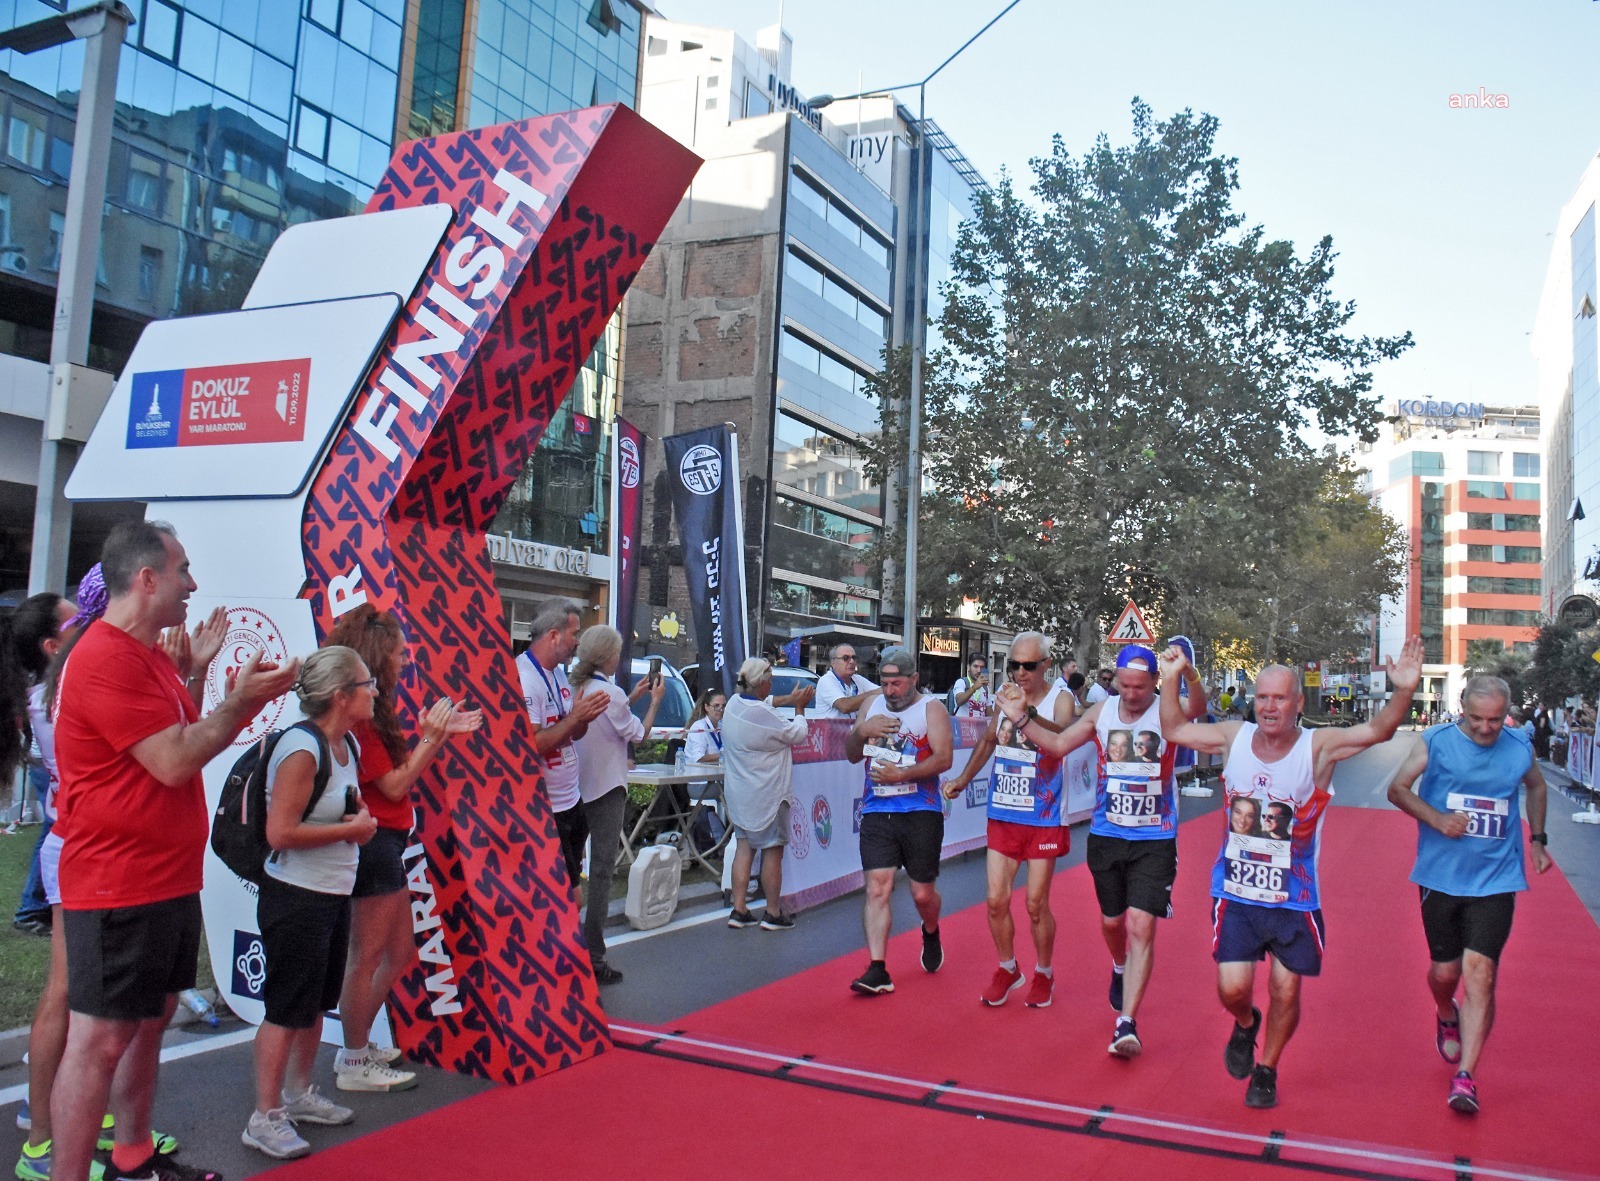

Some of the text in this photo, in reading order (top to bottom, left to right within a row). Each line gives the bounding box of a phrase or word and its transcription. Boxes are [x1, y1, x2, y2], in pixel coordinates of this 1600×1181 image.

[850, 135, 889, 163] my
[353, 167, 548, 464] FINISH
[191, 376, 251, 399] DOKUZ
[289, 372, 301, 426] 11.09.2022
[188, 397, 242, 421] EYLÜL
[1397, 399, 1486, 420] KORDON
[188, 421, 247, 434] YARI MARATONU
[488, 530, 551, 568] ulvar
[555, 545, 592, 576] otel
[943, 639, 961, 652] HOTEL
[996, 774, 1030, 796] 3088
[1110, 793, 1156, 816] 3879
[1454, 810, 1502, 837] 611
[1230, 860, 1283, 892] 3286
